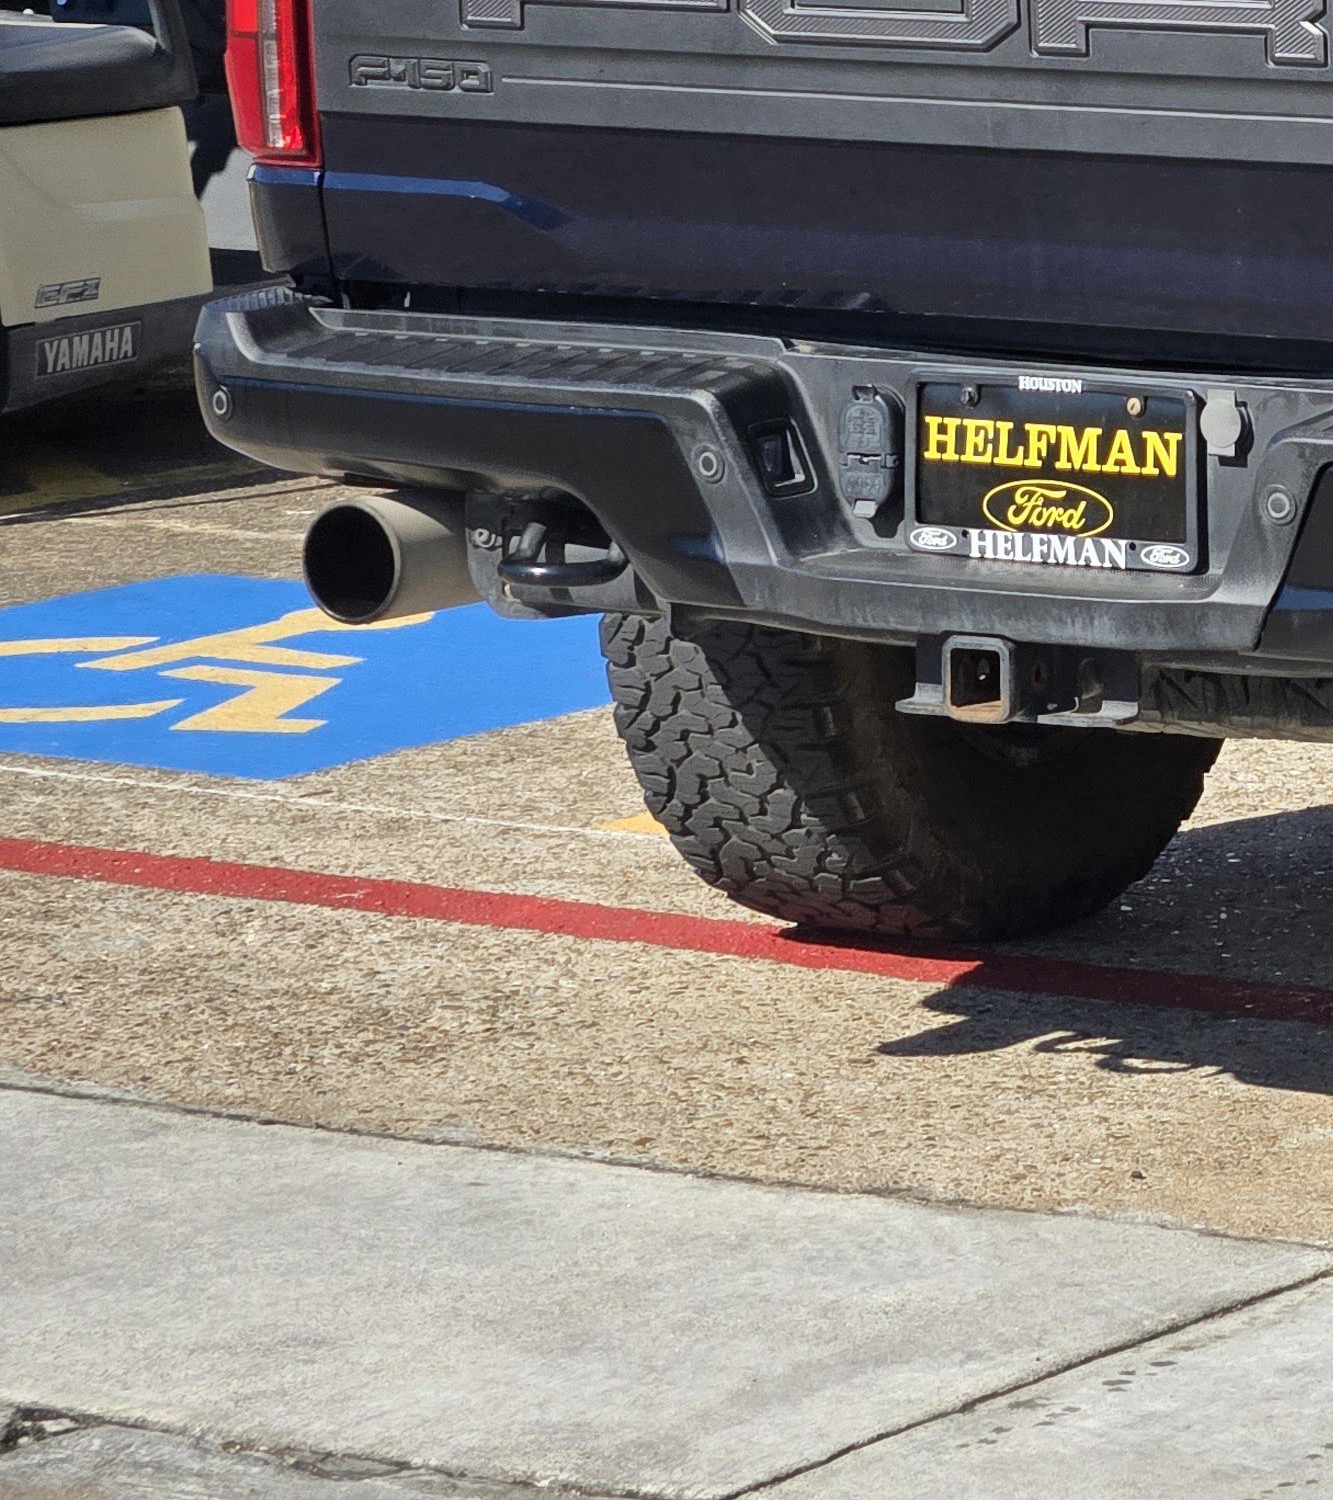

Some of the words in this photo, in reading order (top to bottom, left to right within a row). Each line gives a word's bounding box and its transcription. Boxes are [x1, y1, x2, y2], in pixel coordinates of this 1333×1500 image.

[350, 54, 493, 94] F-150
[44, 326, 134, 374] YAMAHA
[1018, 375, 1083, 394] HOUSTON
[924, 415, 1183, 477] HELFMAN
[1006, 485, 1087, 530] Ford
[917, 529, 950, 547] Ford
[968, 528, 1127, 569] HELFMAN
[1149, 547, 1182, 565] Ford
